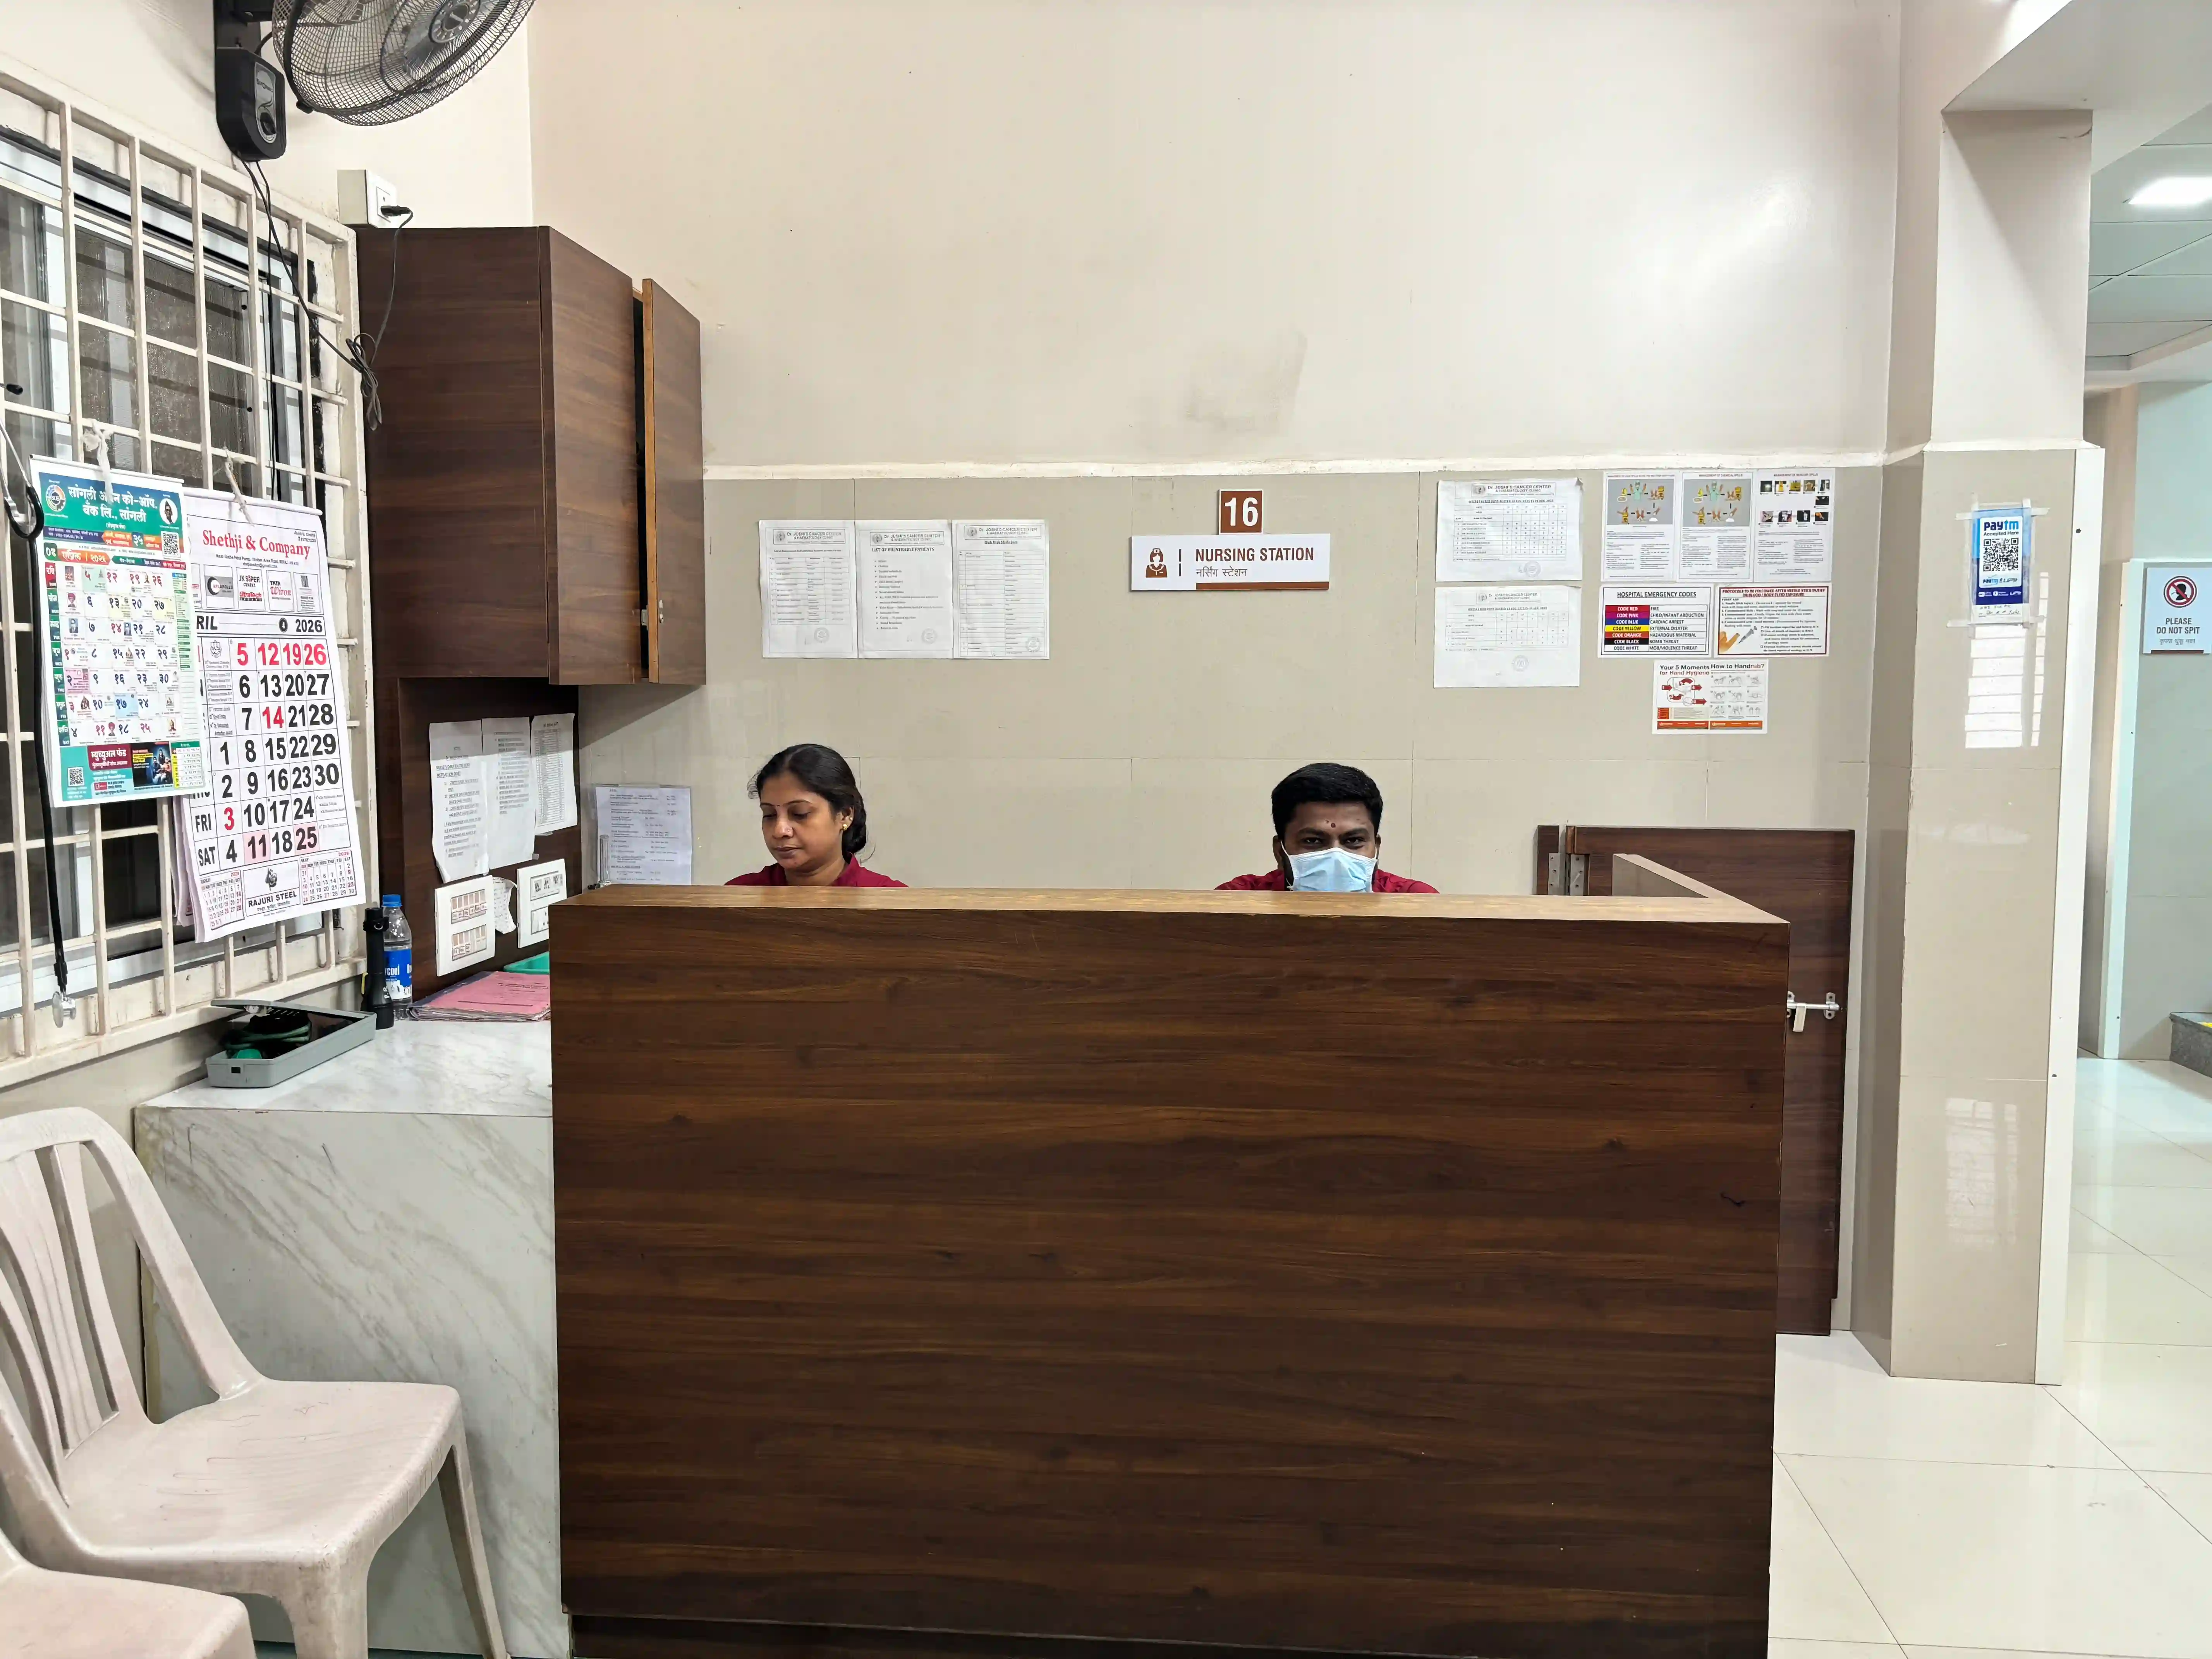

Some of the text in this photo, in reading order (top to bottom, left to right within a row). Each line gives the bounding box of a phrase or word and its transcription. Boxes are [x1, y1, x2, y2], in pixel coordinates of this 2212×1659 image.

[67, 484, 96, 501] सांगली
[82, 500, 98, 516] बँक
[119, 506, 147, 522] सांगली
[1224, 497, 1258, 526] 16
[203, 530, 243, 553] Shethji
[246, 535, 256, 551] &
[259, 537, 311, 560] Company
[1195, 547, 1314, 562] NURSING STATION
[84, 569, 162, 587] ५ १२ १९ २६
[1196, 565, 1247, 577] नर्सिंग स्टेशन
[270, 586, 291, 596] Wiron
[87, 596, 165, 611] ६ १३ २० २७
[88, 622, 166, 635] ७ १४ २१ २८
[196, 615, 218, 630] RIL
[295, 619, 323, 633] 2026
[64, 648, 168, 660] १ ८ १५ २२ २९
[237, 643, 327, 666] 5 12 19 26
[239, 675, 250, 698] 6
[260, 674, 282, 697] 13
[285, 674, 304, 696] 20
[306, 674, 329, 695] 27
[241, 708, 252, 730] 7
[262, 706, 284, 729] 14
[288, 705, 306, 727] 21
[309, 703, 334, 726] 28
[117, 747, 127, 757] फंड
[220, 733, 336, 765] 1 8 15 22 29
[222, 763, 339, 798] 2 9 16 23 30
[195, 813, 211, 833] FRI
[224, 807, 235, 831] 3
[244, 802, 265, 827] 10
[270, 799, 289, 823] 17
[293, 796, 314, 820] 24
[198, 826, 317, 867] SAT 4 11 18 25
[248, 895, 273, 907] RAJURI
[276, 891, 297, 902] STEEL
